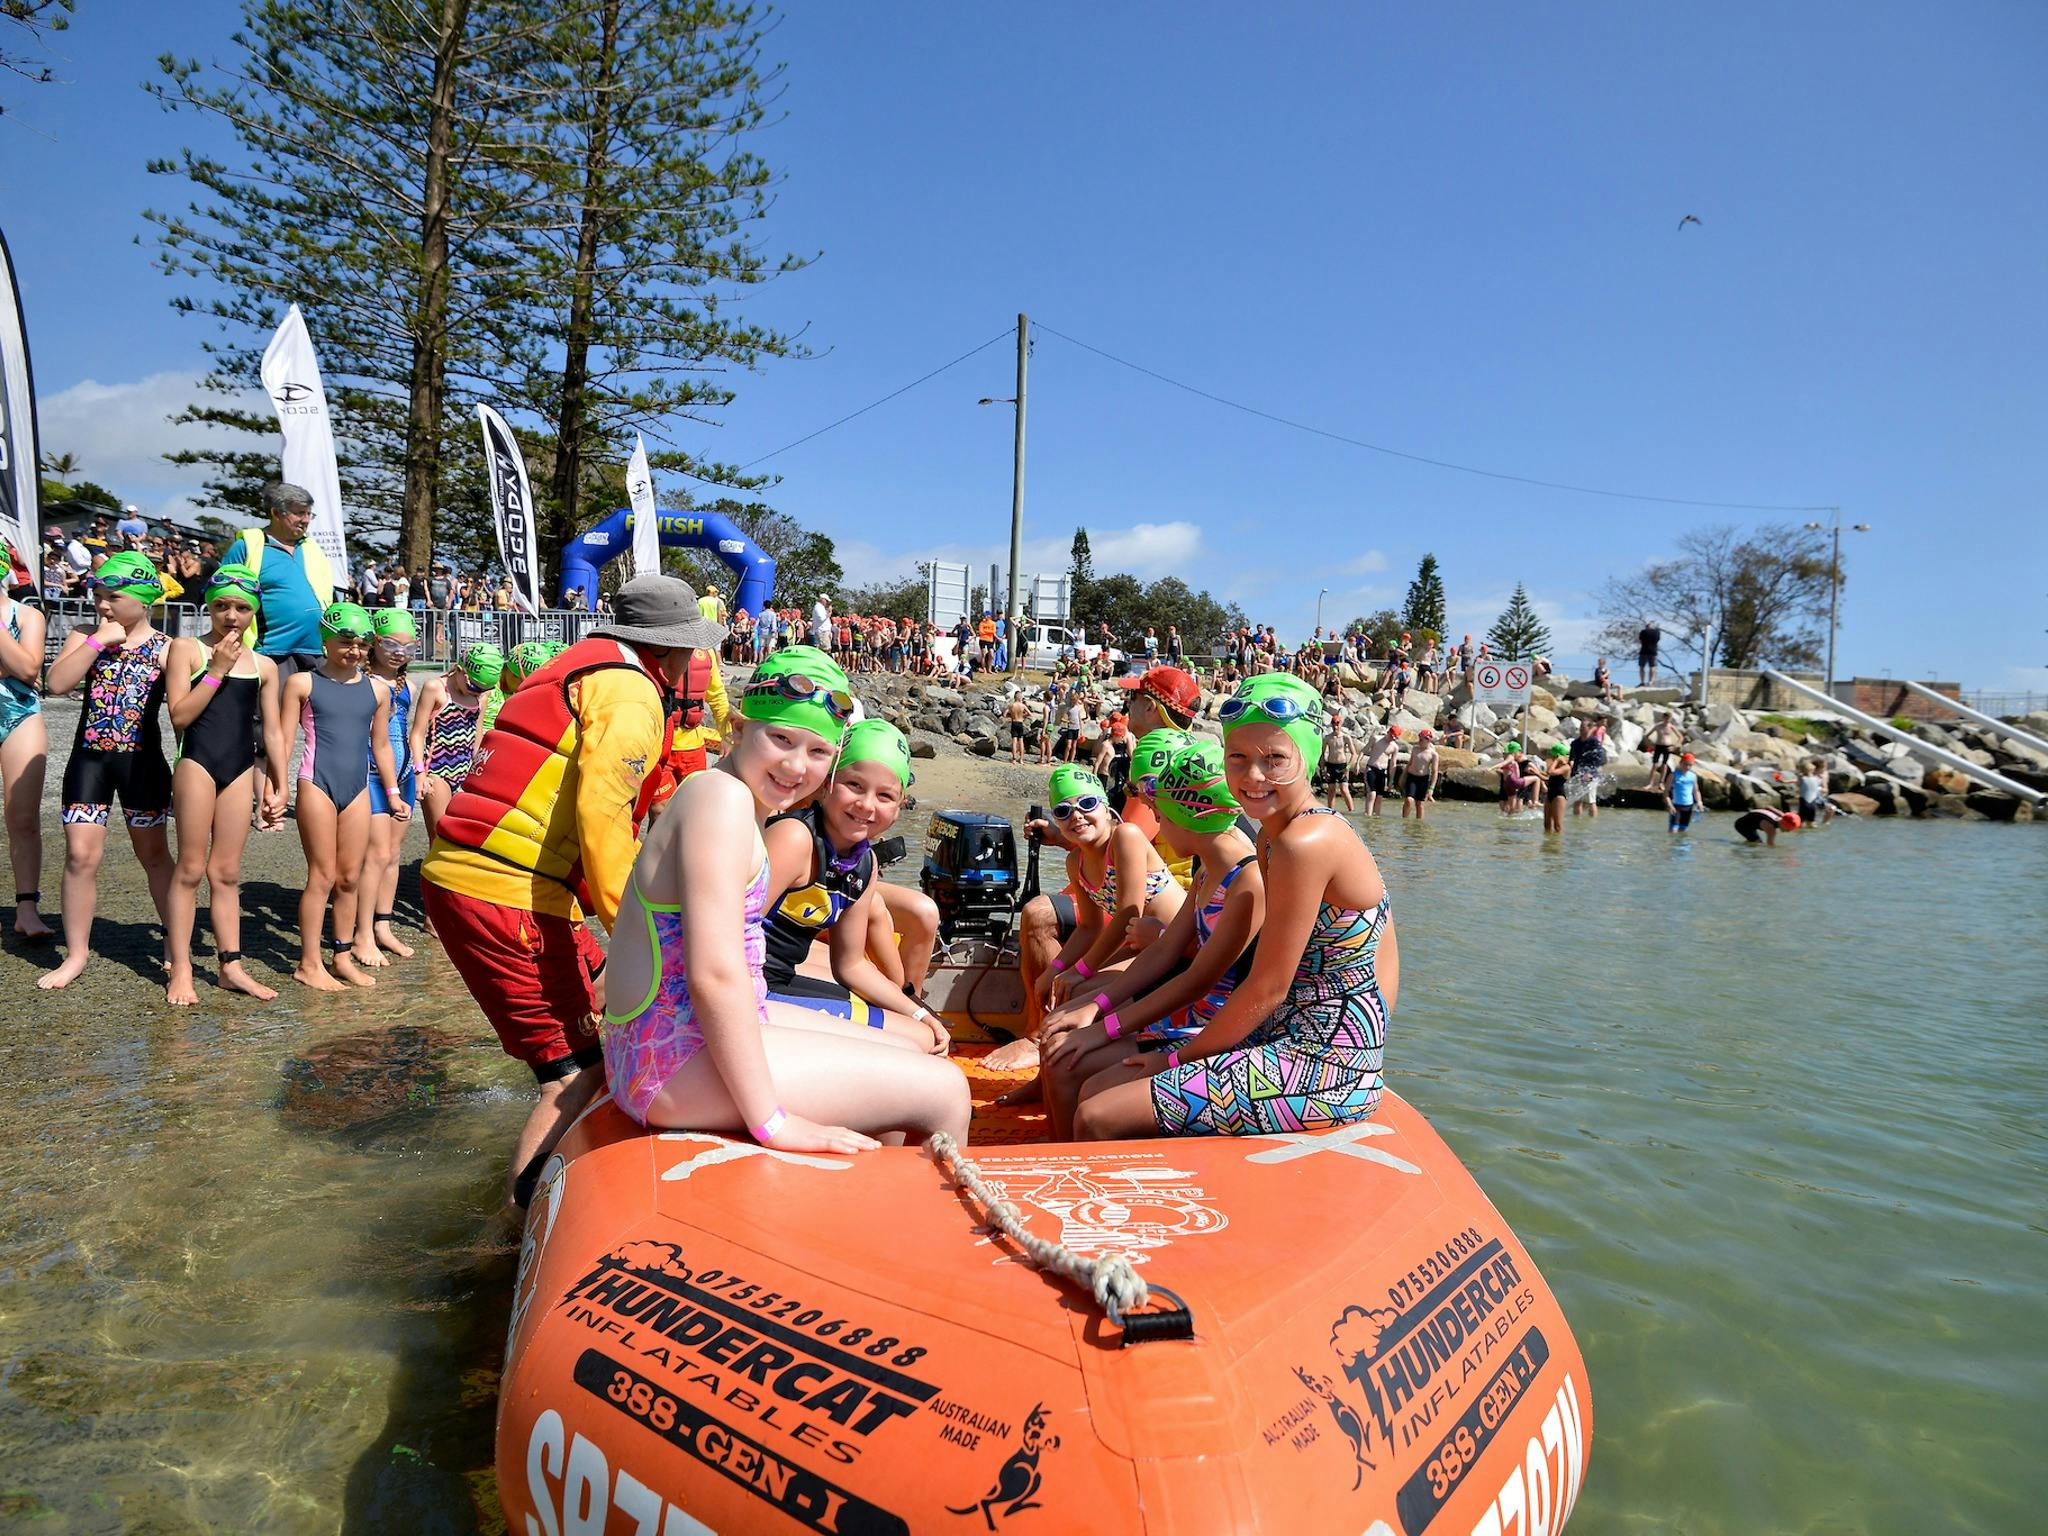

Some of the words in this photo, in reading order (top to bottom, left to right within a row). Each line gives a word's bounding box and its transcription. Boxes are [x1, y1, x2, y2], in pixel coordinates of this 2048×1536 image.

[625, 514, 704, 536] FISH
[1484, 671, 1494, 684] 6
[1388, 1227, 1483, 1309] 0755206888
[556, 1257, 922, 1437] THUNDERCAT
[695, 1269, 929, 1369] 0755206888
[1341, 1251, 1523, 1460] THUNDERCAT
[567, 1305, 865, 1465] INFLATABLES
[1400, 1288, 1535, 1448] INFLATABLES
[929, 1398, 1011, 1442] AUSTRALIAN
[939, 1424, 982, 1453] MADE
[1291, 1425, 1321, 1454] MADE
